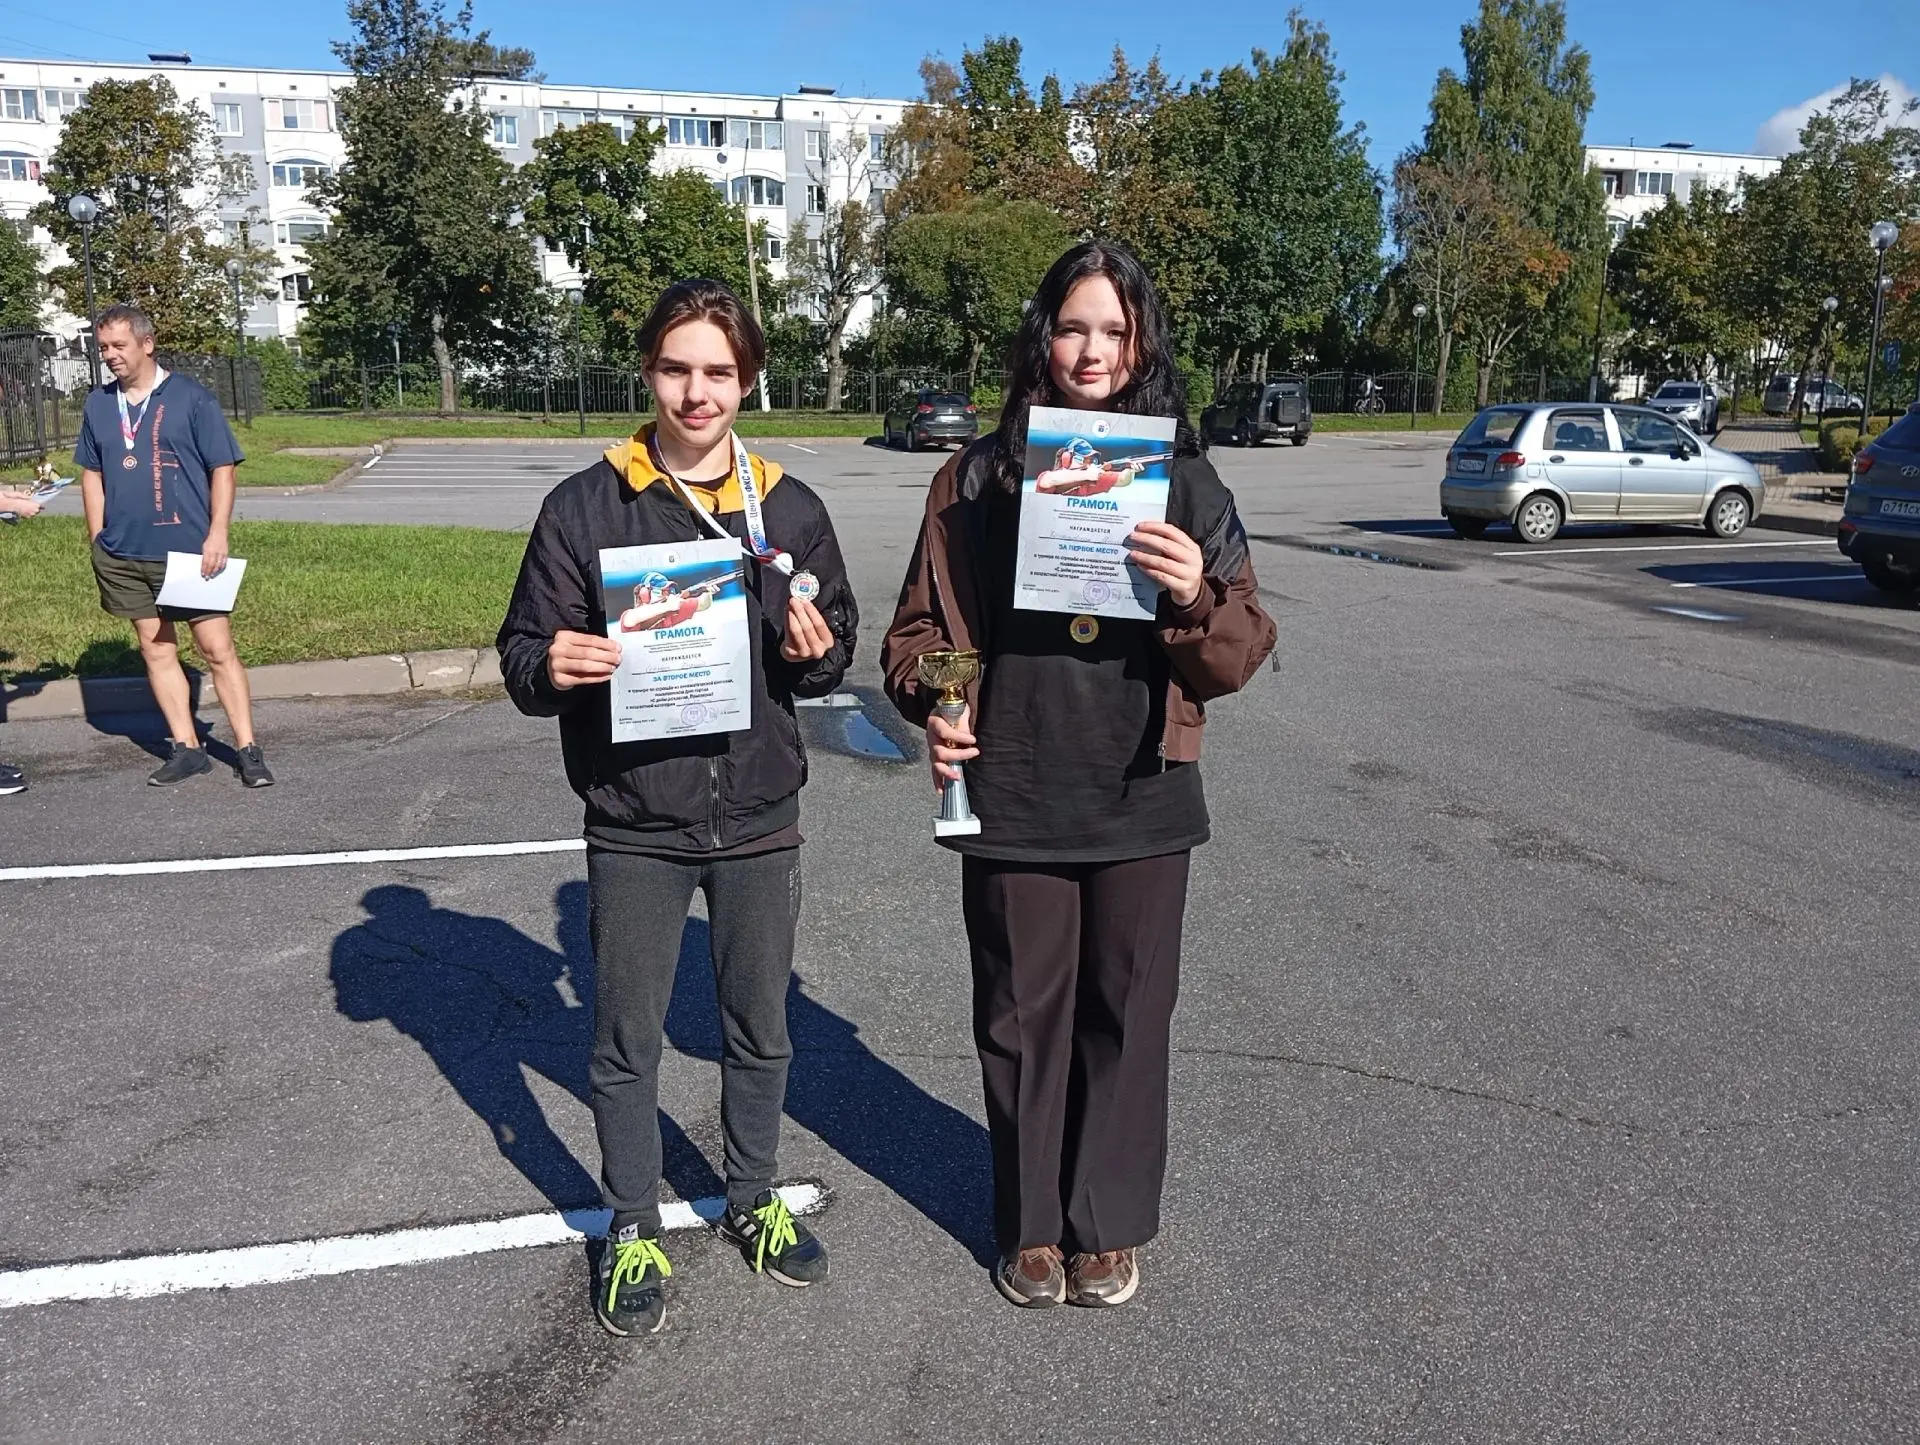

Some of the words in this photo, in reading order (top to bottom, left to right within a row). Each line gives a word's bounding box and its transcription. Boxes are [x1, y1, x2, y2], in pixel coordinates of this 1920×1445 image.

[742, 476, 753, 493] ФКС
[1067, 497, 1119, 511] ГРАМОТА
[1069, 525, 1111, 534] НАГРАЖДАЕТСЯ
[1058, 543, 1068, 551] ЗА
[1069, 544, 1094, 553] ПЕРВОЕ
[1095, 546, 1119, 555] МЕСТО
[654, 626, 705, 640] ГРАМОТА
[661, 653, 702, 662] НАГРАЖДАЕТСЯ
[662, 673, 688, 681] ВТОРОЕ
[689, 670, 711, 678] МЕСТО
